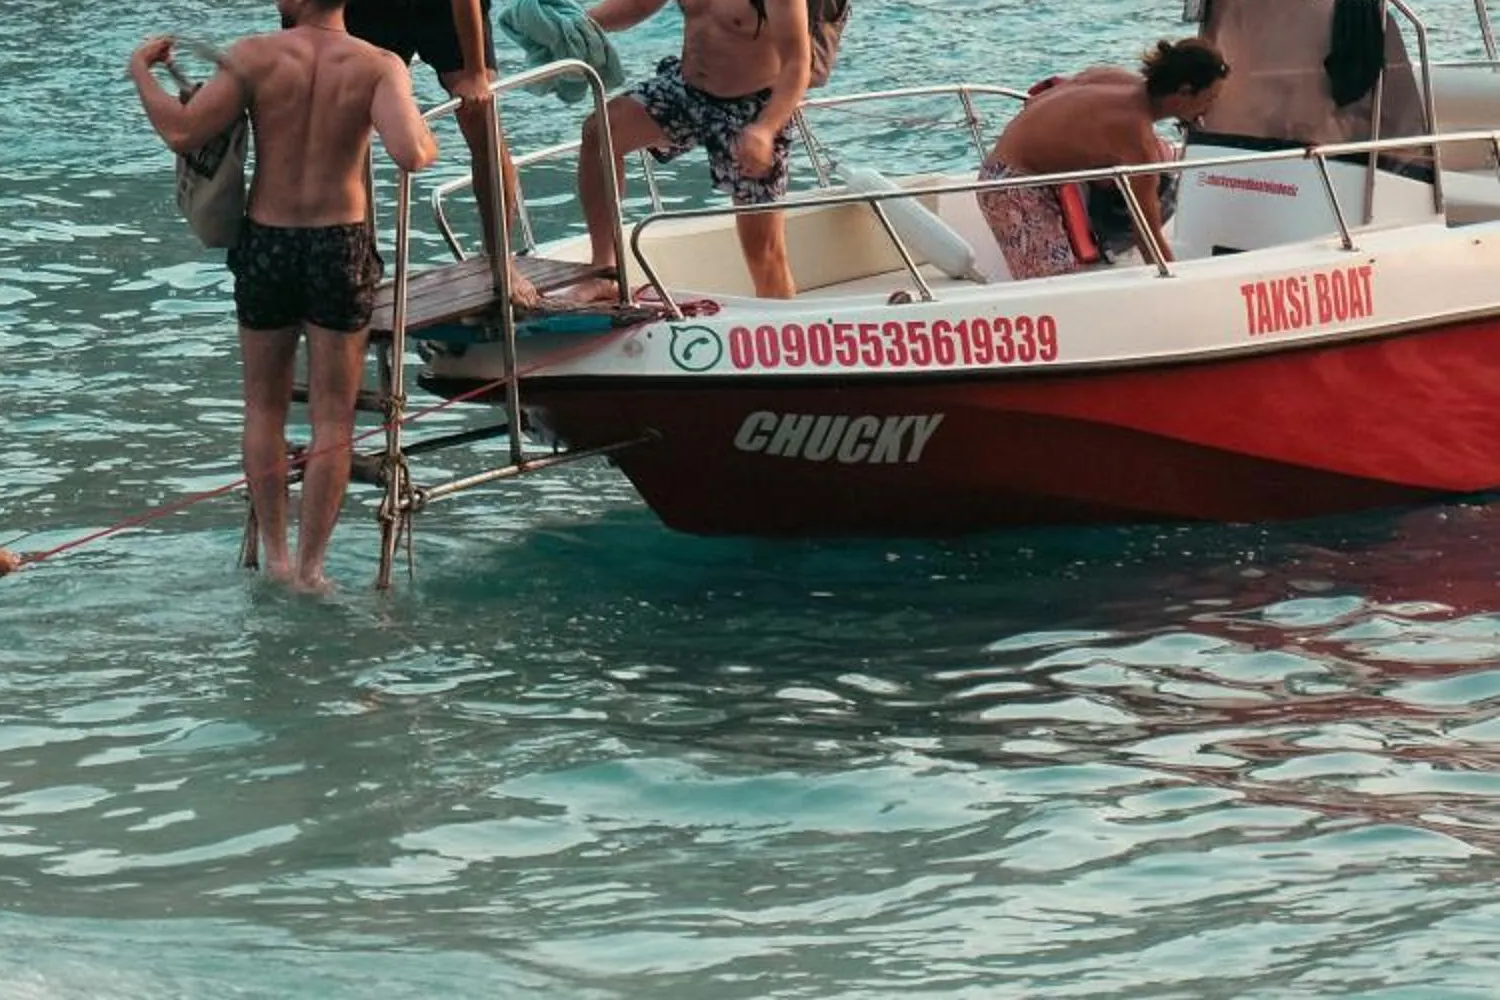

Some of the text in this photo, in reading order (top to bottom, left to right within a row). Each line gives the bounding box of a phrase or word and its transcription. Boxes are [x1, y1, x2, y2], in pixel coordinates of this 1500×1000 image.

[1314, 265, 1373, 324] BOAT
[728, 314, 1059, 370] 00905535619339
[733, 410, 945, 465] CHUCKY
